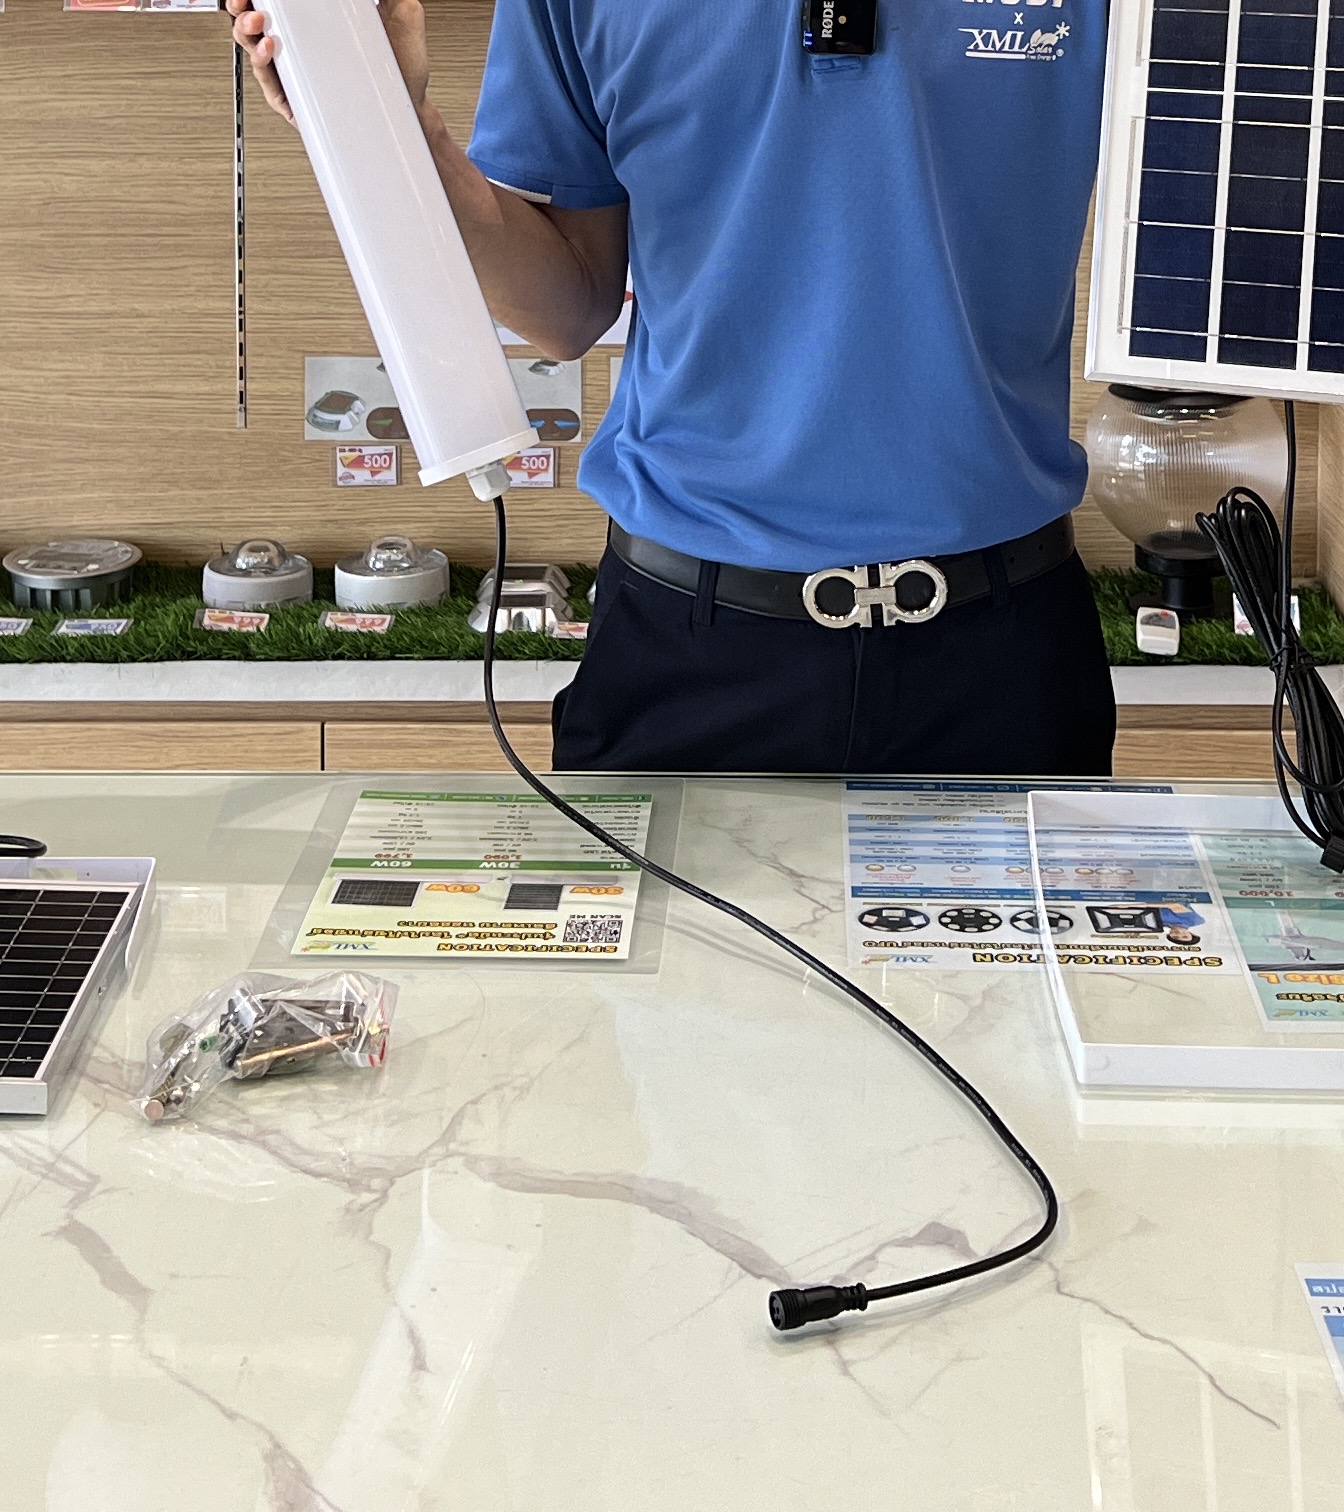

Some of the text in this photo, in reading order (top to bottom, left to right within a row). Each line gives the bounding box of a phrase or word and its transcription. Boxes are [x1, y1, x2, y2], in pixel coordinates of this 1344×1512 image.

[821, 0, 835, 38] RØDE
[958, 27, 1029, 52] XML
[363, 454, 390, 468] 500
[521, 456, 547, 470] 500
[370, 859, 414, 868] 60W
[479, 860, 522, 869] 30W
[437, 943, 619, 954] SPECIFICATION
